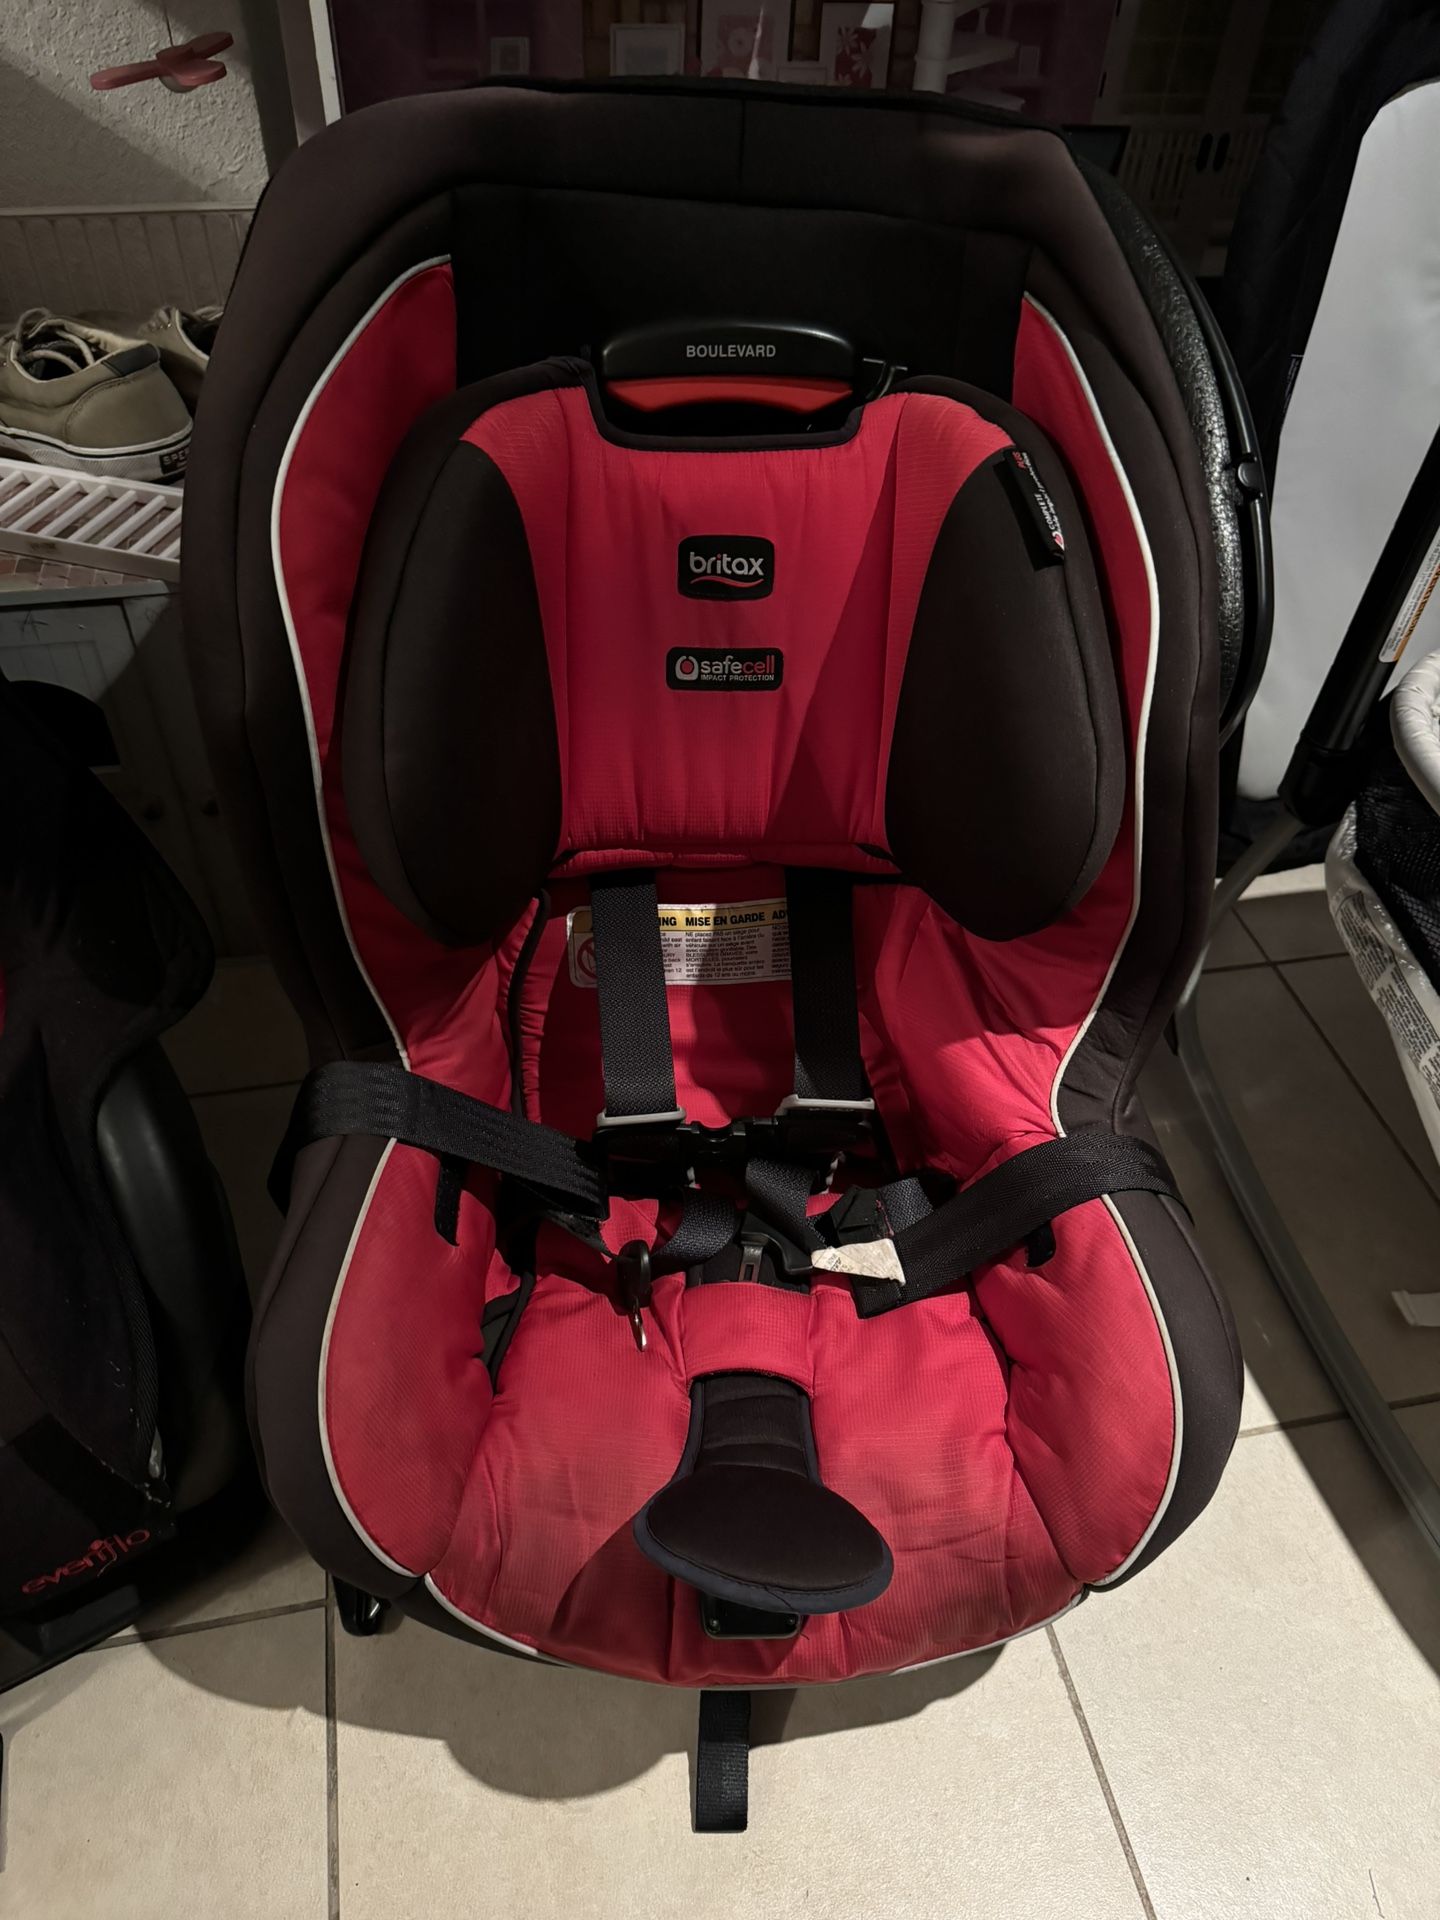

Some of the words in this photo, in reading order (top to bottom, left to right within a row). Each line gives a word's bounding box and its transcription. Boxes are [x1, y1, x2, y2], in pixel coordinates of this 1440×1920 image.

[685, 344, 777, 358] BOULEVARD
[1033, 492, 1056, 530] COMPLETE
[689, 551, 765, 576] britax
[700, 655, 775, 674] safecell
[658, 916, 677, 926] ING
[685, 916, 711, 926] MISE
[713, 916, 728, 925] EN
[730, 912, 765, 924] GARDE
